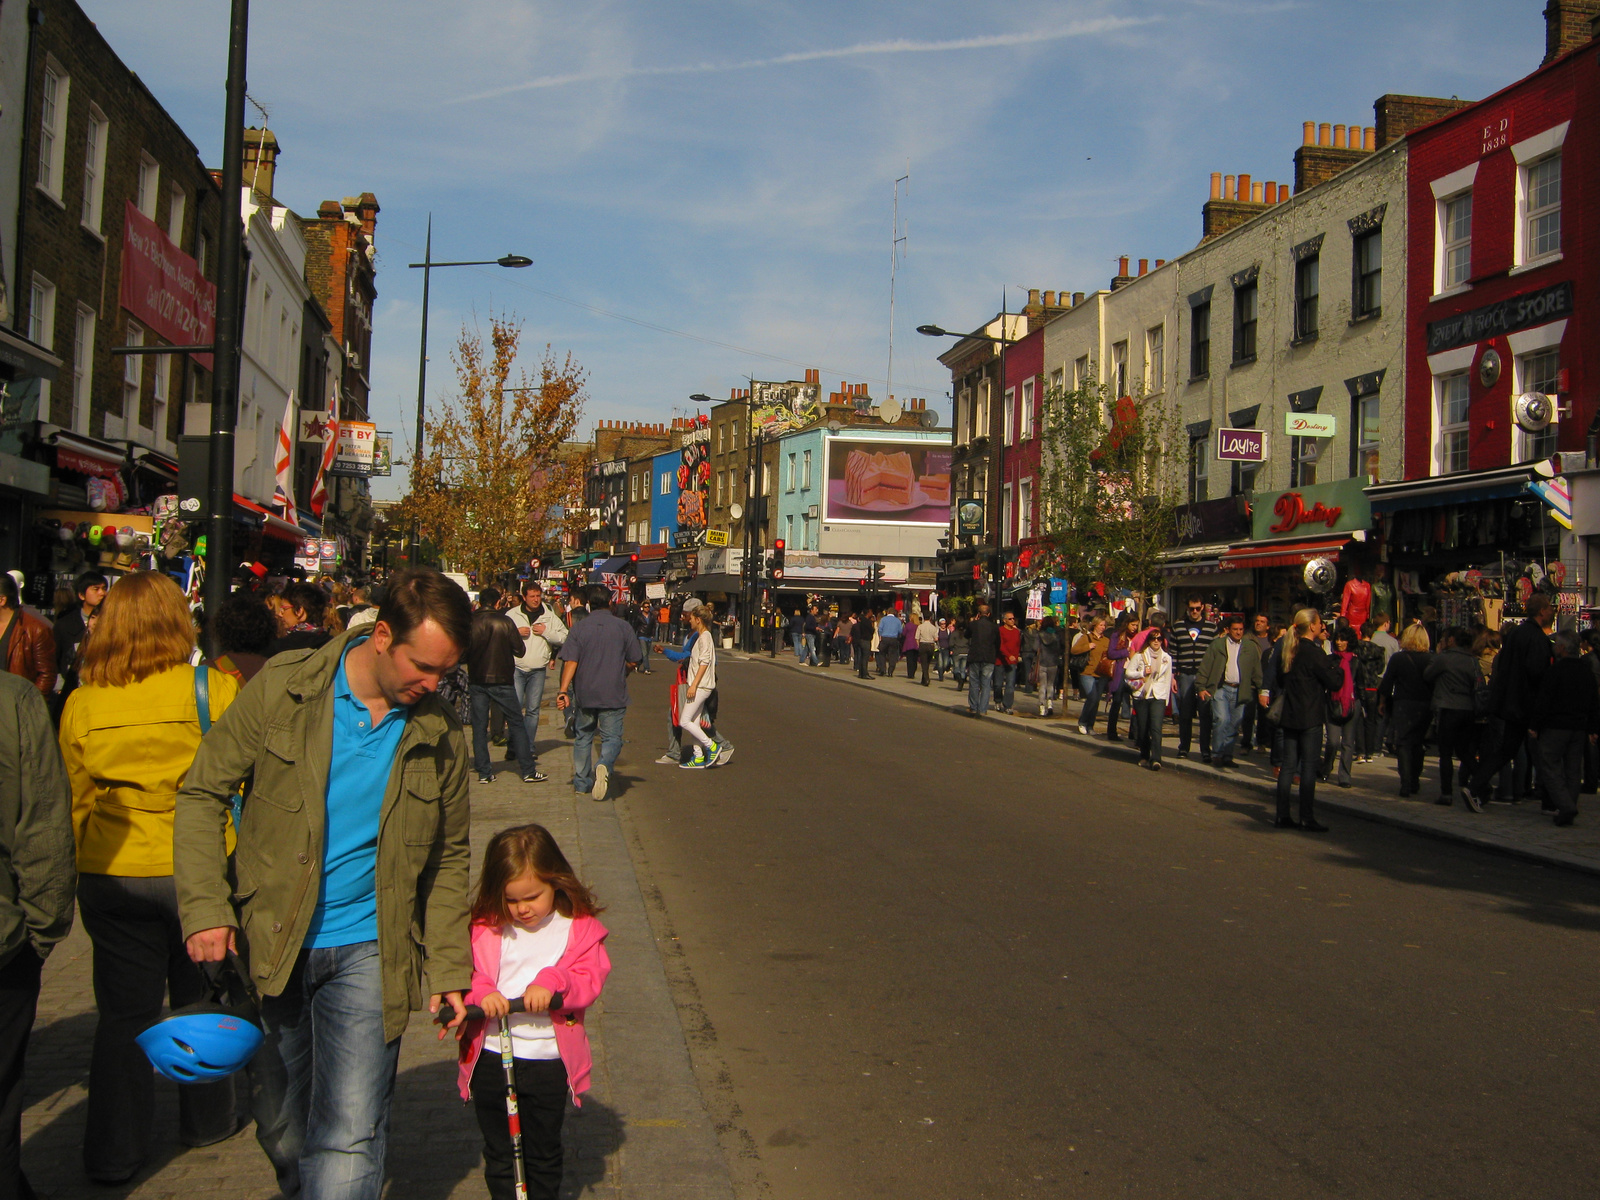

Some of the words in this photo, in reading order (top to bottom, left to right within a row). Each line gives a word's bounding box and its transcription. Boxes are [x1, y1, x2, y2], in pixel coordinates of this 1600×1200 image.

[1499, 118, 1509, 132] D
[1482, 134, 1506, 154] 1838
[128, 221, 143, 252] New
[144, 236, 149, 257] 2
[158, 288, 175, 321] 020
[1432, 321, 1462, 347] NEW
[1475, 308, 1509, 330] ROCK
[1516, 289, 1566, 322] STORE
[356, 430, 372, 440] BY
[1290, 418, 1328, 432] Destiny
[1222, 435, 1260, 455] Laylie
[1174, 508, 1203, 539] Laylie
[1269, 492, 1342, 533] Destiny
